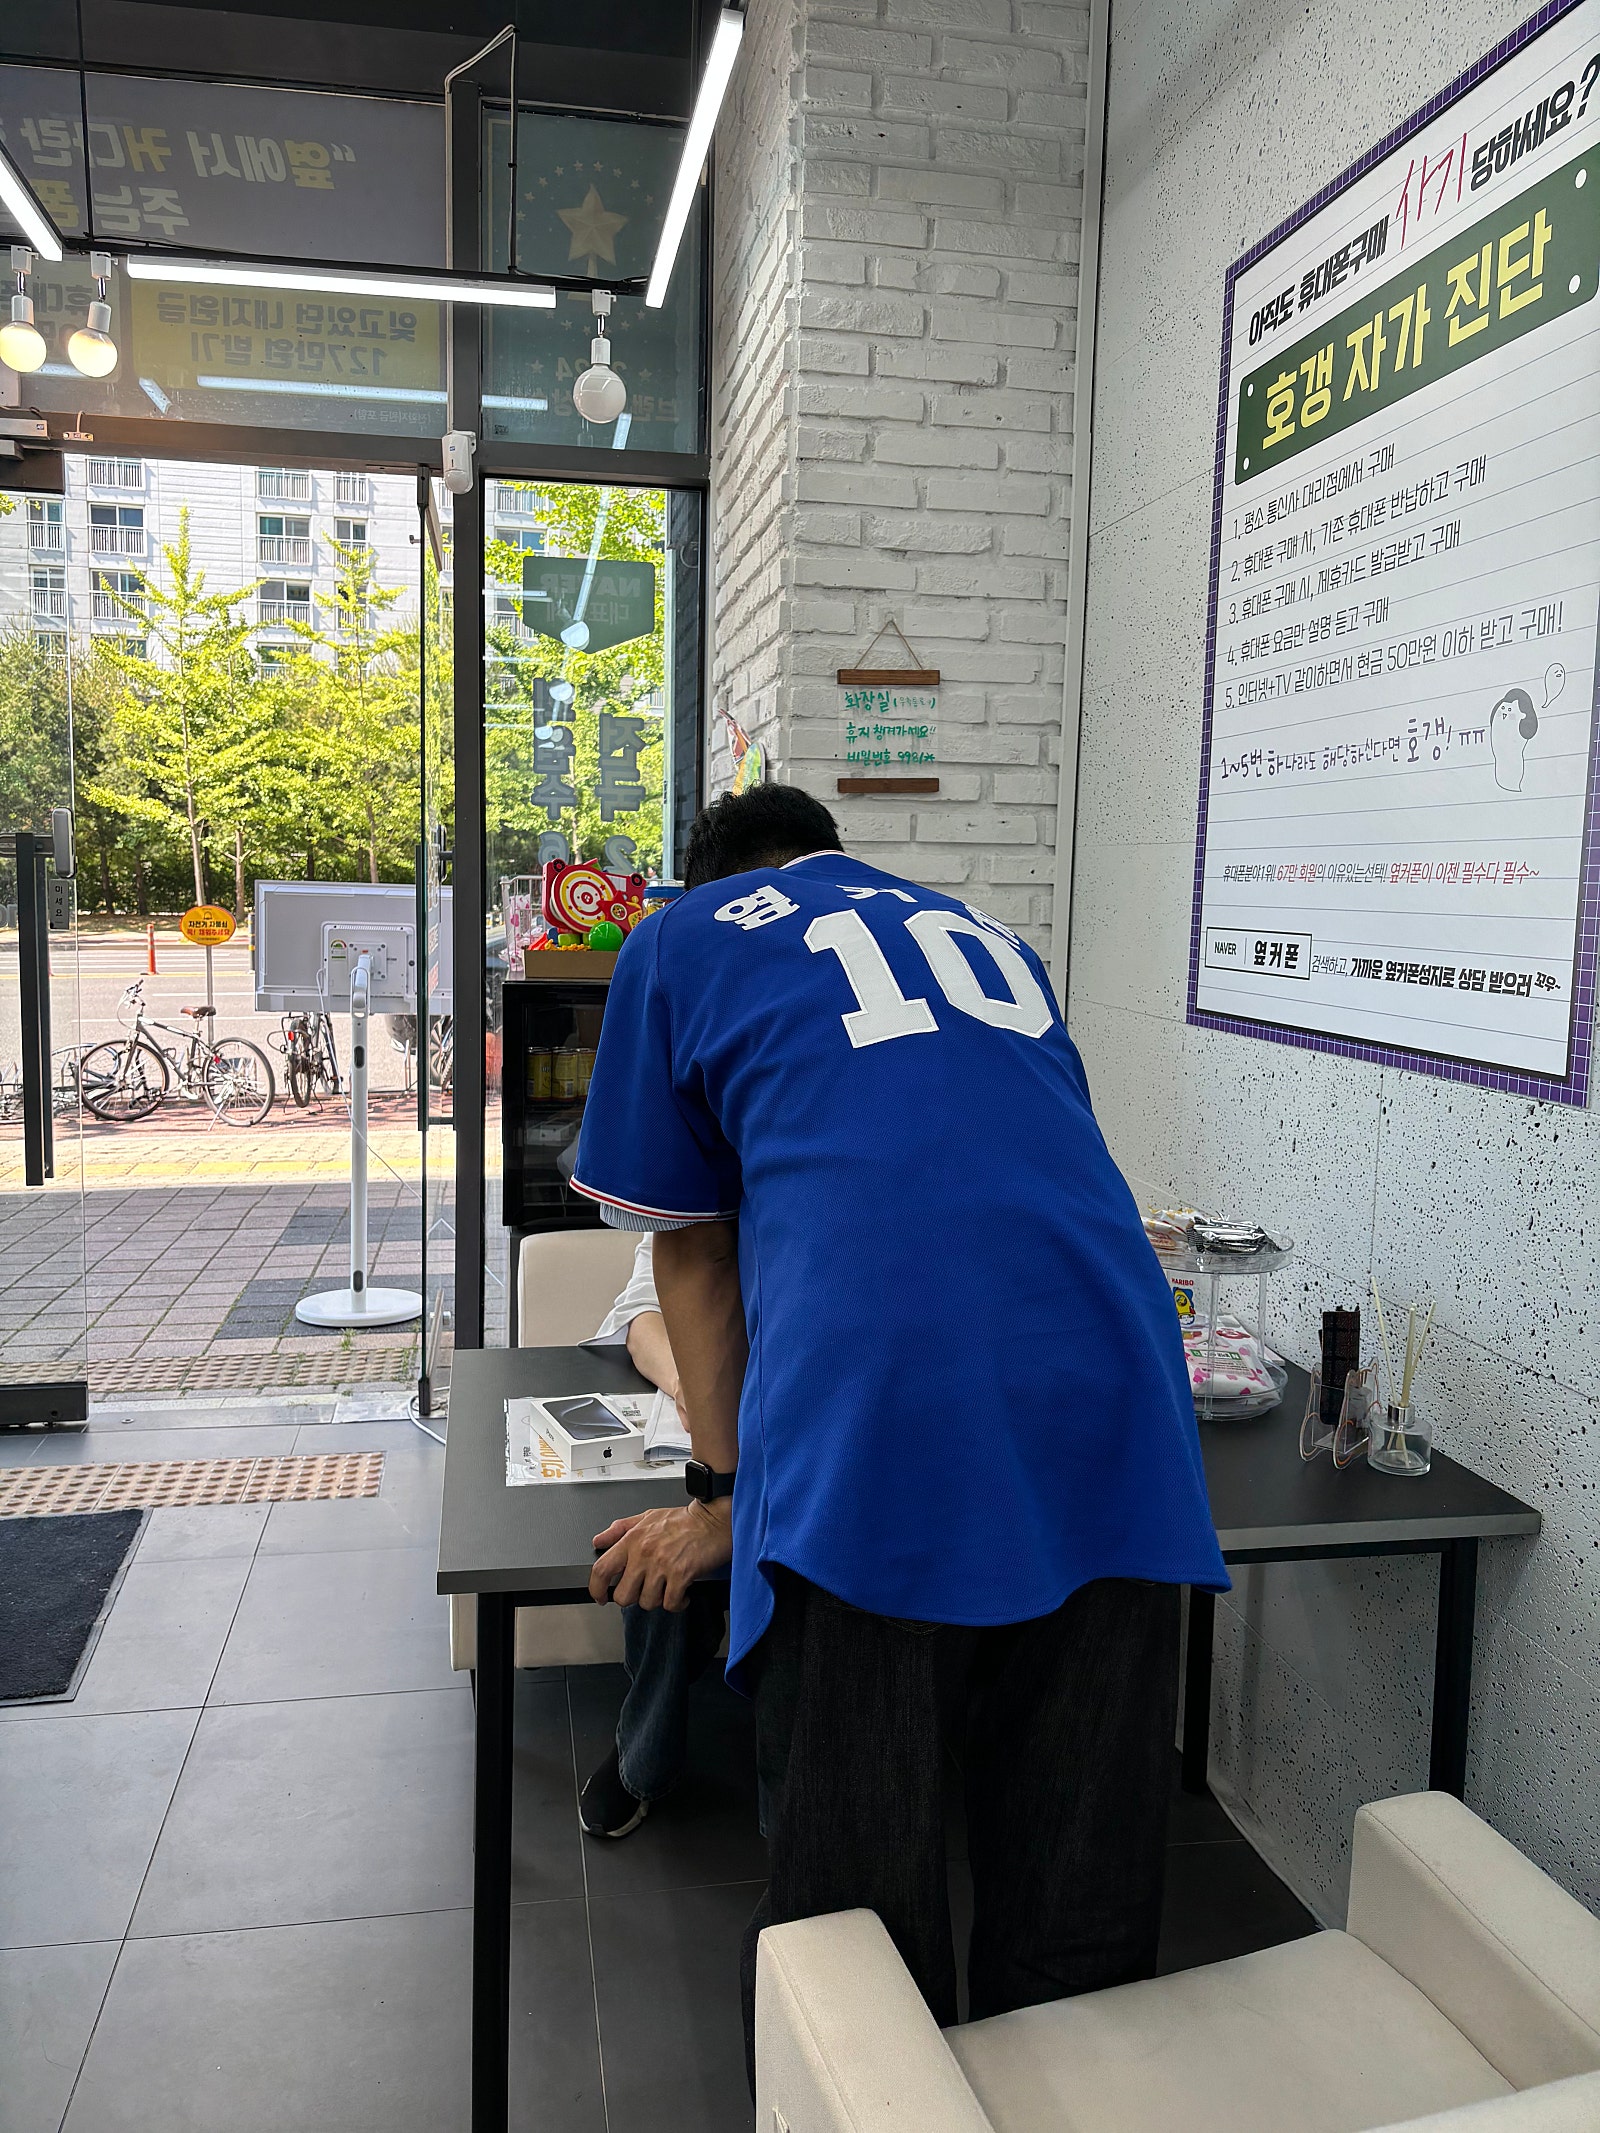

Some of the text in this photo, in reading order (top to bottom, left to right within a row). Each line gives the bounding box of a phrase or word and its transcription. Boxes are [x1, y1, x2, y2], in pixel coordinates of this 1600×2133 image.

[1249, 285, 1297, 346] 아직도
[1299, 214, 1390, 312] 휴대폰구매
[1395, 132, 1468, 250] 사기
[1262, 207, 1554, 450] 호갱 자가 진단
[1231, 560, 1240, 583] 2.
[1244, 545, 1273, 577] 휴대폰
[1276, 535, 1298, 564] 구매
[1321, 515, 1344, 546] 기존
[1348, 497, 1386, 536] 휴대폰
[1391, 470, 1449, 519] 반납하고
[1454, 454, 1486, 492] 구매
[1234, 443, 1394, 539] 1. 평소 통신사 대리점에서 구매
[1228, 602, 1239, 624] 3.
[1242, 589, 1271, 620] 휴대폰
[1274, 580, 1296, 608] 구매
[1318, 555, 1366, 595] 제휴카드
[1371, 532, 1425, 577] 발급받고
[1430, 519, 1461, 554] 구매
[1225, 600, 1563, 709] 5. 인터넷+TV 같이하면서 현금 50만원 이하 받고 구매!
[1227, 596, 1390, 666] 4. 휴대폰 요금만 설명 듣고 구매
[845, 691, 890, 713] 화장실
[845, 721, 870, 744] 휴지
[847, 748, 891, 767] 비밀번호
[1267, 750, 1316, 777] 하나라도
[1322, 735, 1400, 771] 해당하신다면
[1277, 864, 1298, 882] 67만
[1389, 862, 1433, 884] 옆커폰이
[1435, 862, 1460, 884] 이젠
[1462, 861, 1500, 884] 필수다
[803, 908, 1054, 1049] 10
[1214, 941, 1237, 955] NAVER
[1350, 957, 1383, 979] 가까운
[1385, 960, 1456, 987] 옆커폰성지로
[1458, 968, 1487, 991] 상담
[1488, 971, 1533, 997] 받으러
